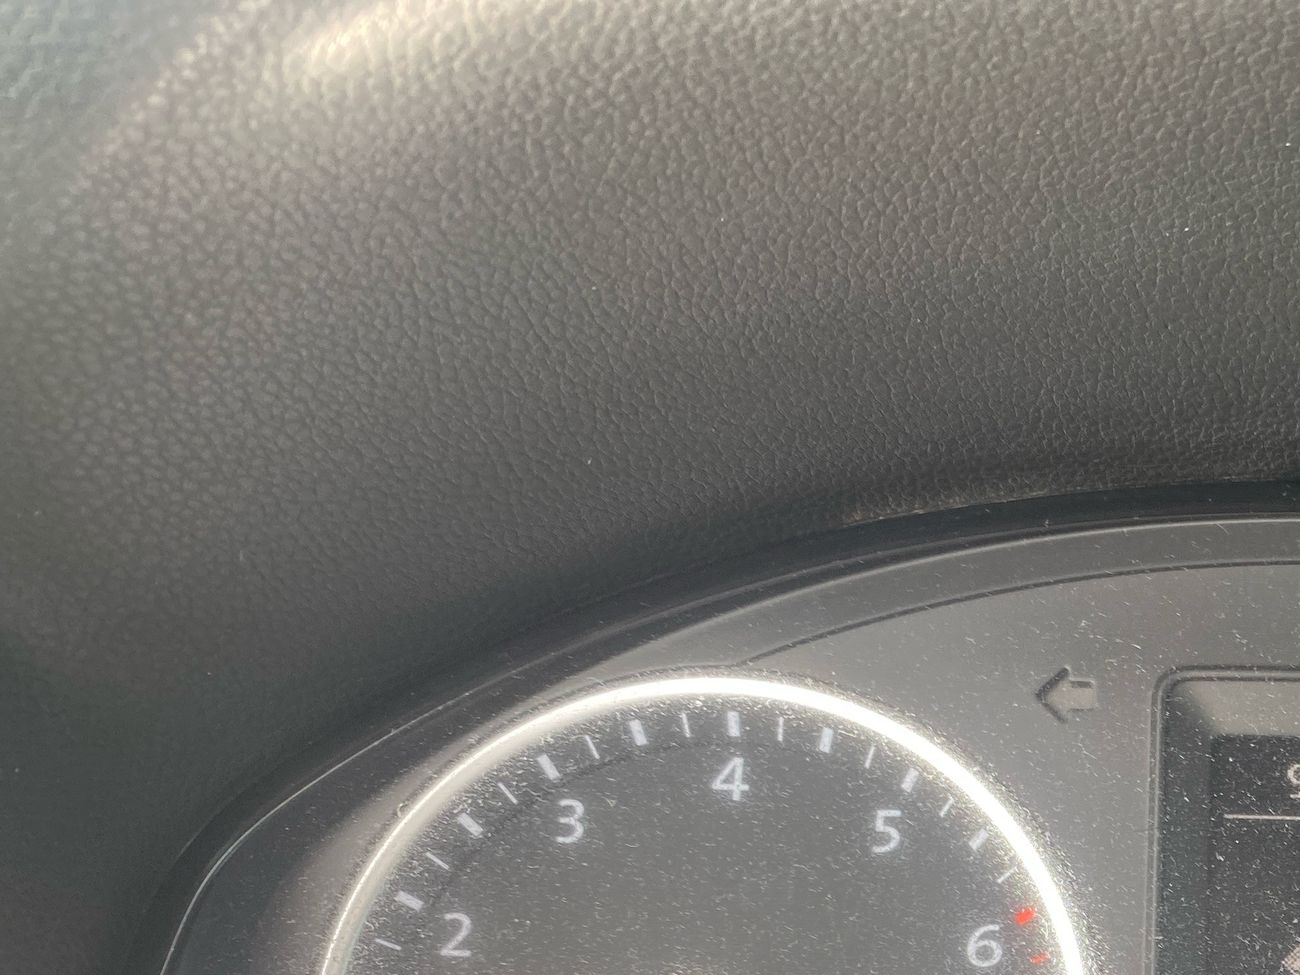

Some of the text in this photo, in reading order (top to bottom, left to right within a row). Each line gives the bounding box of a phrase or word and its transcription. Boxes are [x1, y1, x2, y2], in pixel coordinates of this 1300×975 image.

[711, 756, 749, 800] 4
[557, 800, 585, 842] 3
[873, 810, 900, 853] 5
[440, 913, 472, 957] 2
[967, 925, 1002, 967] 6
